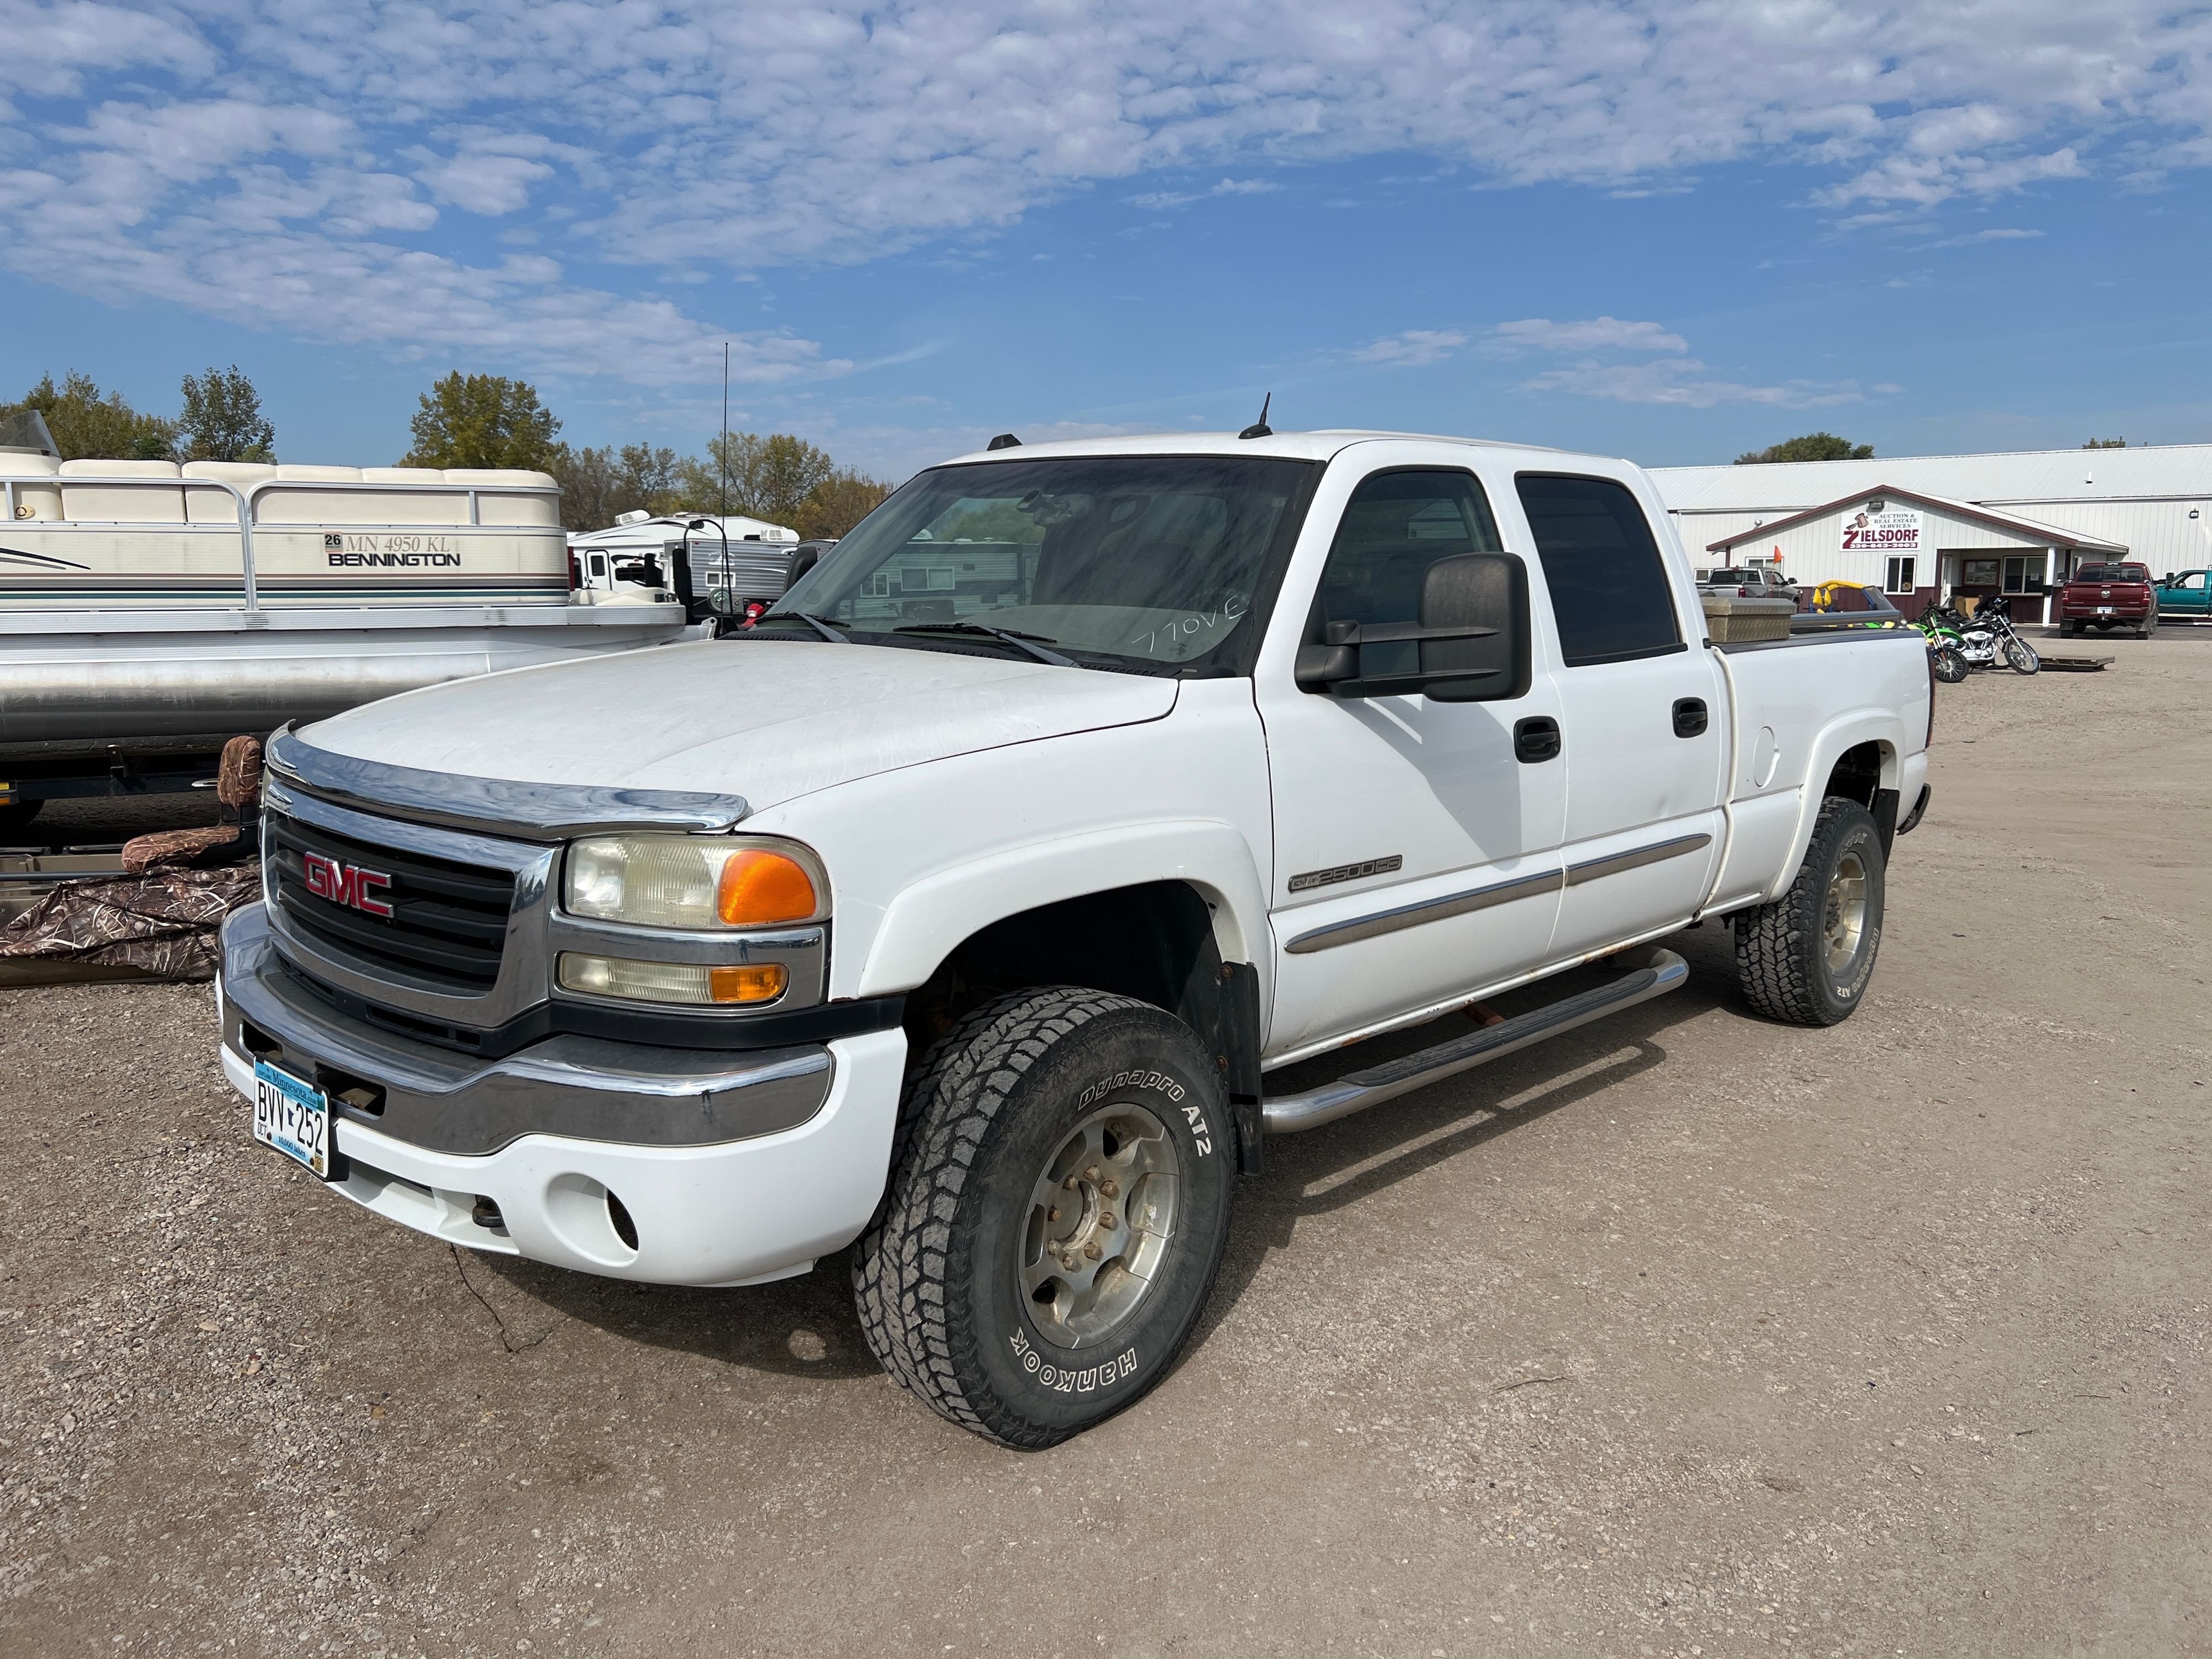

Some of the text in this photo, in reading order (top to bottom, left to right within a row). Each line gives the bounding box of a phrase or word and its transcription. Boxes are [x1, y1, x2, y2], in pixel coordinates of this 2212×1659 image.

[325, 534, 341, 545] 26
[346, 535, 451, 552] MN 4950 KL
[1843, 529, 1919, 549] ZIELSDORF
[328, 553, 461, 567] BENNINGTON
[1319, 856, 1402, 885] 2500HD
[304, 851, 394, 918] GMC
[257, 1121, 267, 1137] OCT
[258, 1081, 323, 1156] BVV 252
[1181, 1106, 1212, 1157] AT2
[278, 1135, 306, 1157] 10,000 lakes
